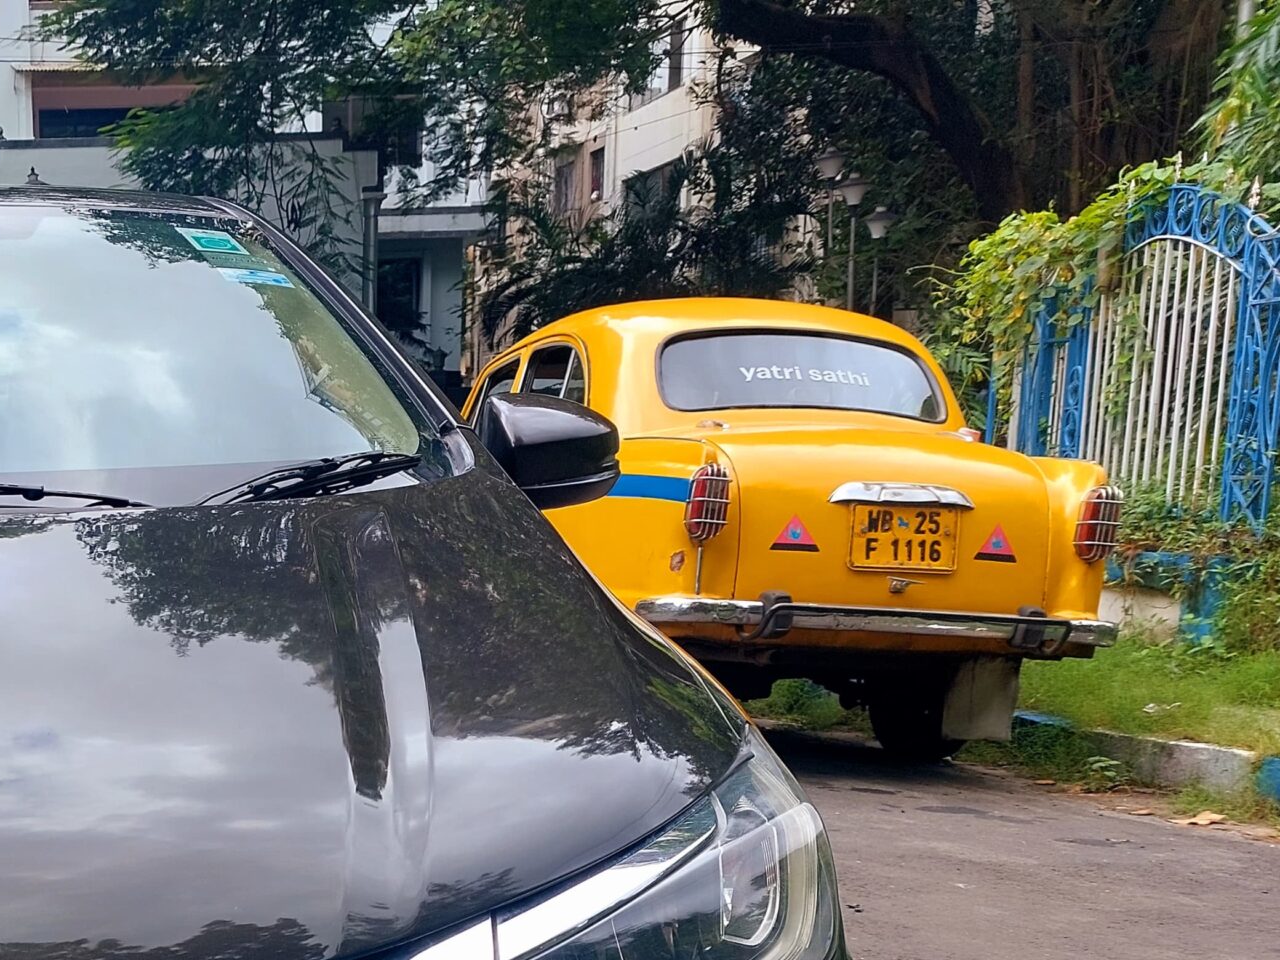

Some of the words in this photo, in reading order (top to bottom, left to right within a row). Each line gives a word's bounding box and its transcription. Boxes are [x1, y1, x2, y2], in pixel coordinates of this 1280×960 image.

[738, 364, 803, 382] yatri
[807, 368, 871, 387] sathi
[866, 509, 894, 533] WB
[913, 510, 942, 535] 25
[864, 537, 879, 561] F
[890, 538, 942, 563] 1116
